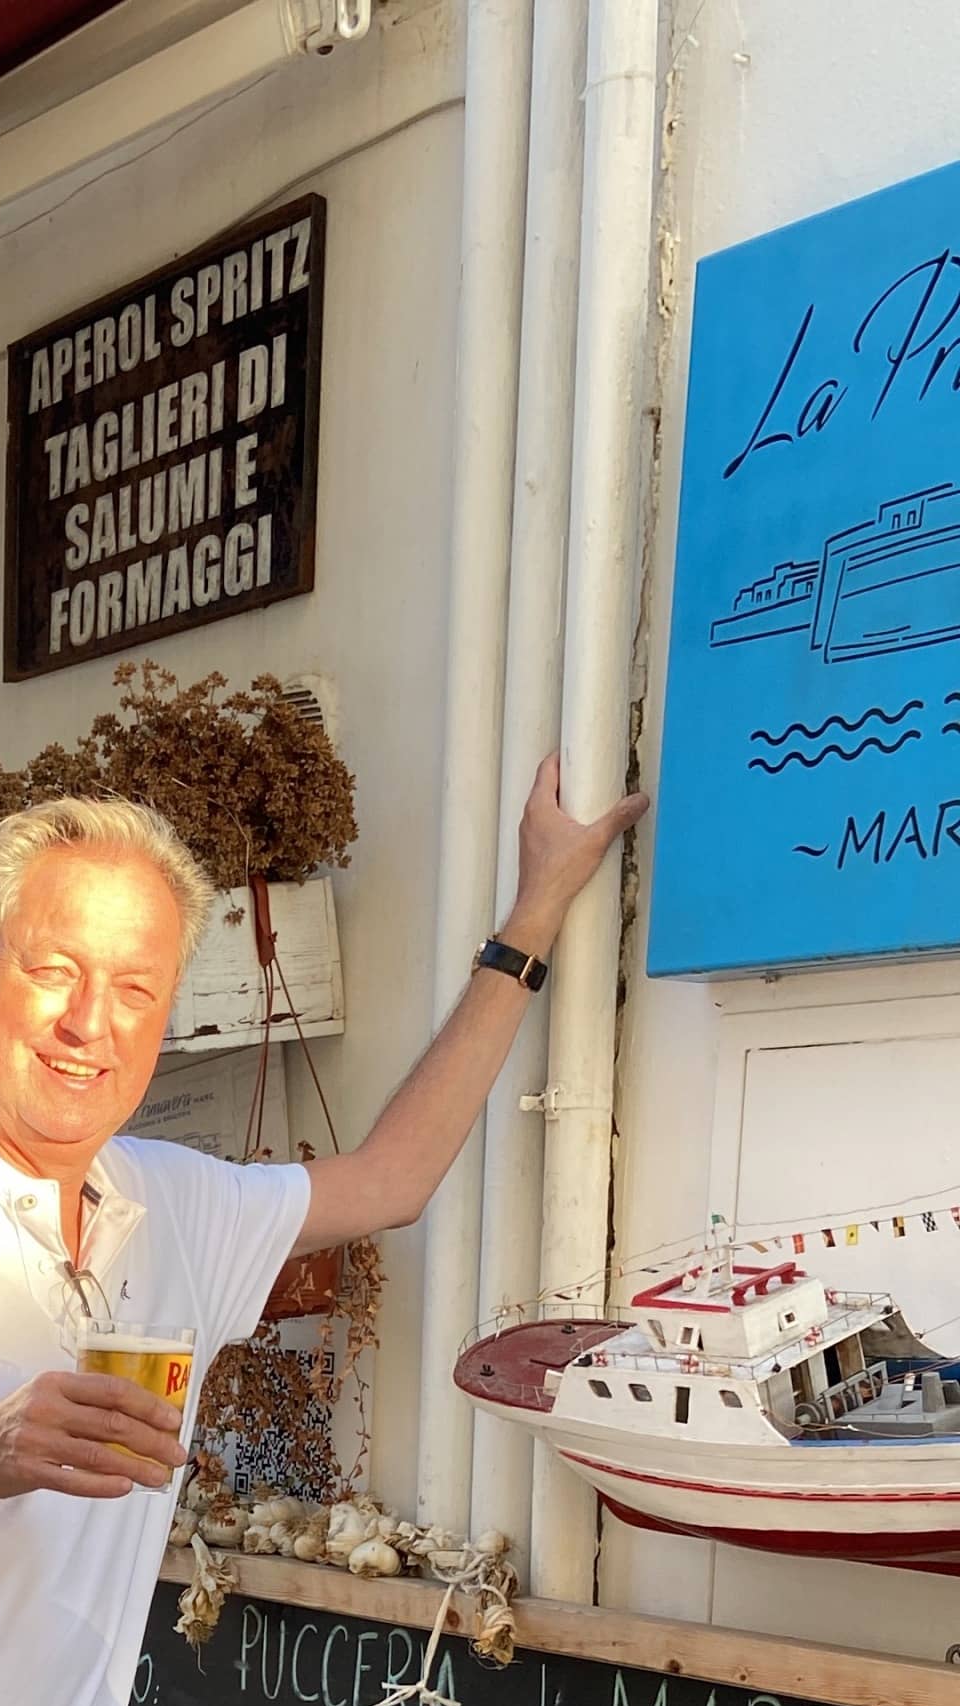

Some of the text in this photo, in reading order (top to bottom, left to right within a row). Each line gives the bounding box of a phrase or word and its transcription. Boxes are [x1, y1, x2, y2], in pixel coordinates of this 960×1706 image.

[28, 216, 313, 415] APEROL SPRITZ
[722, 247, 960, 480] La Pr
[45, 333, 288, 500] TAGLIERI DI
[48, 514, 272, 655] FORMAGGI
[64, 433, 258, 571] SALUMI E
